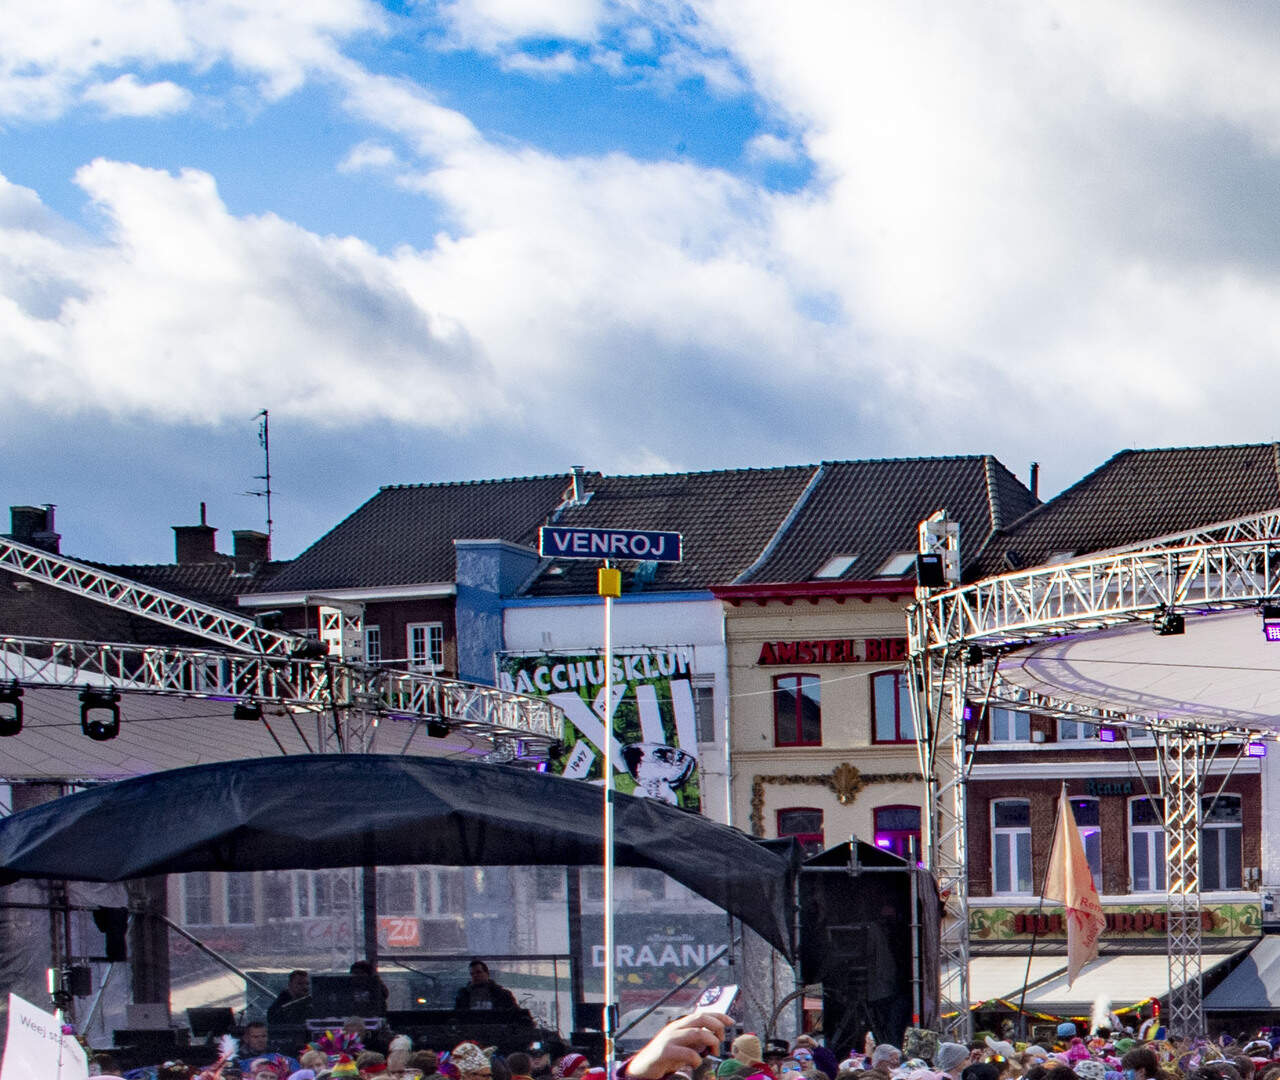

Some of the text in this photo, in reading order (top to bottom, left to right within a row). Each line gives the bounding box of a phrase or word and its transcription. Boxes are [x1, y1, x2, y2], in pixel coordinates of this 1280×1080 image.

[552, 532, 665, 556] VENROJ
[758, 638, 908, 665] AMSTEL BIE
[591, 944, 729, 968] DRAANK
